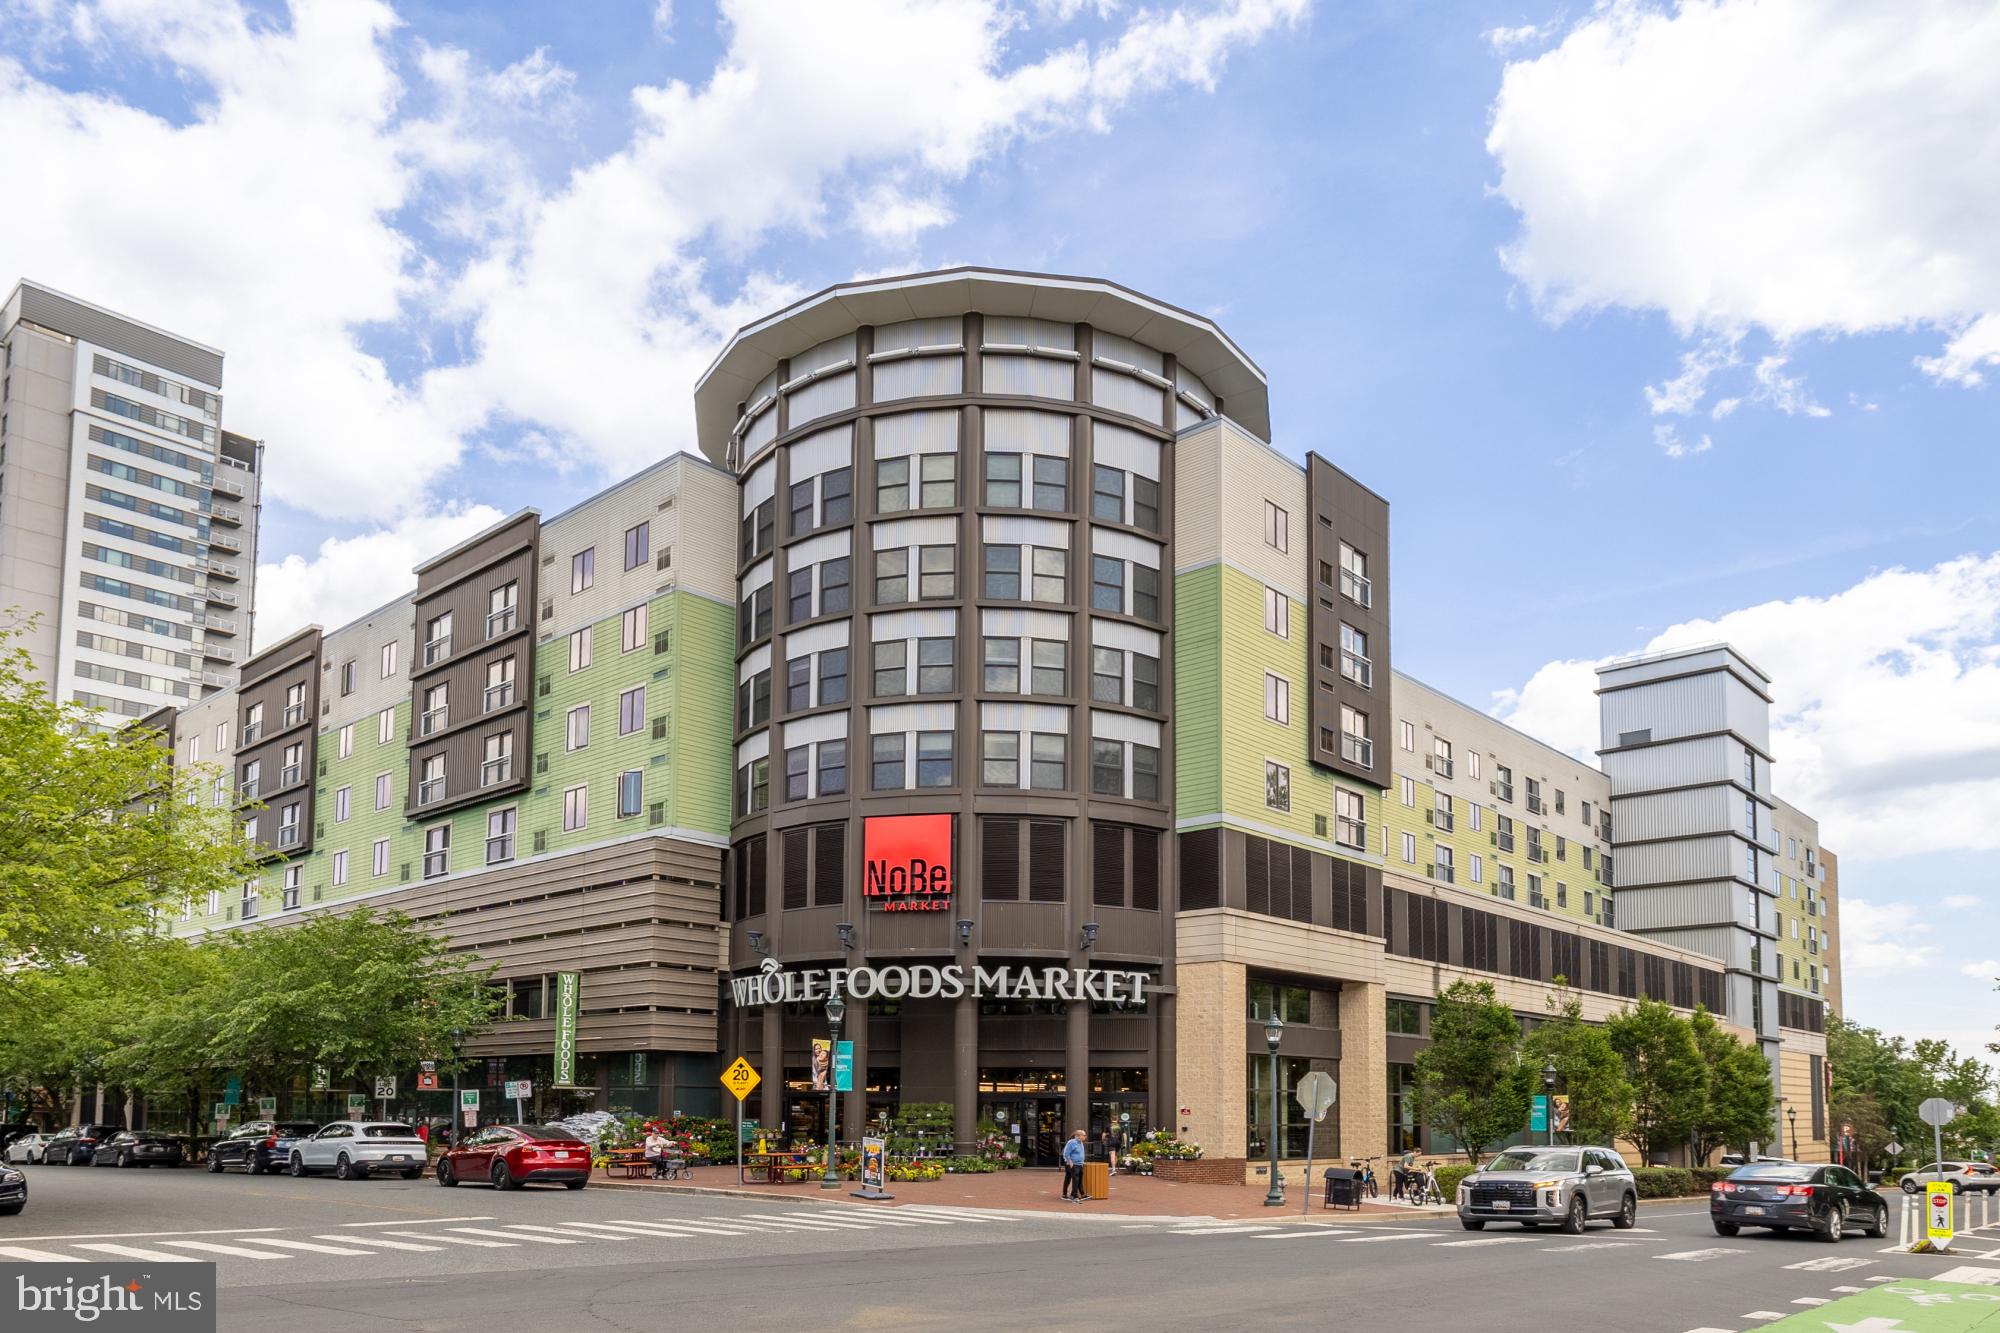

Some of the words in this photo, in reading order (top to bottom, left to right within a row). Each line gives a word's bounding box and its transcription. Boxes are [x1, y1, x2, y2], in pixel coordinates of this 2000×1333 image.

[868, 858, 947, 895] NoBe
[884, 901, 950, 912] MARKET
[562, 974, 575, 1028] WHOLE
[731, 957, 824, 1008] WHOLE
[827, 965, 965, 1000] FOODS
[971, 965, 1150, 1004] MARKET
[560, 1030, 573, 1080] FOODS
[377, 1087, 394, 1096] 20
[733, 1069, 749, 1081] 20
